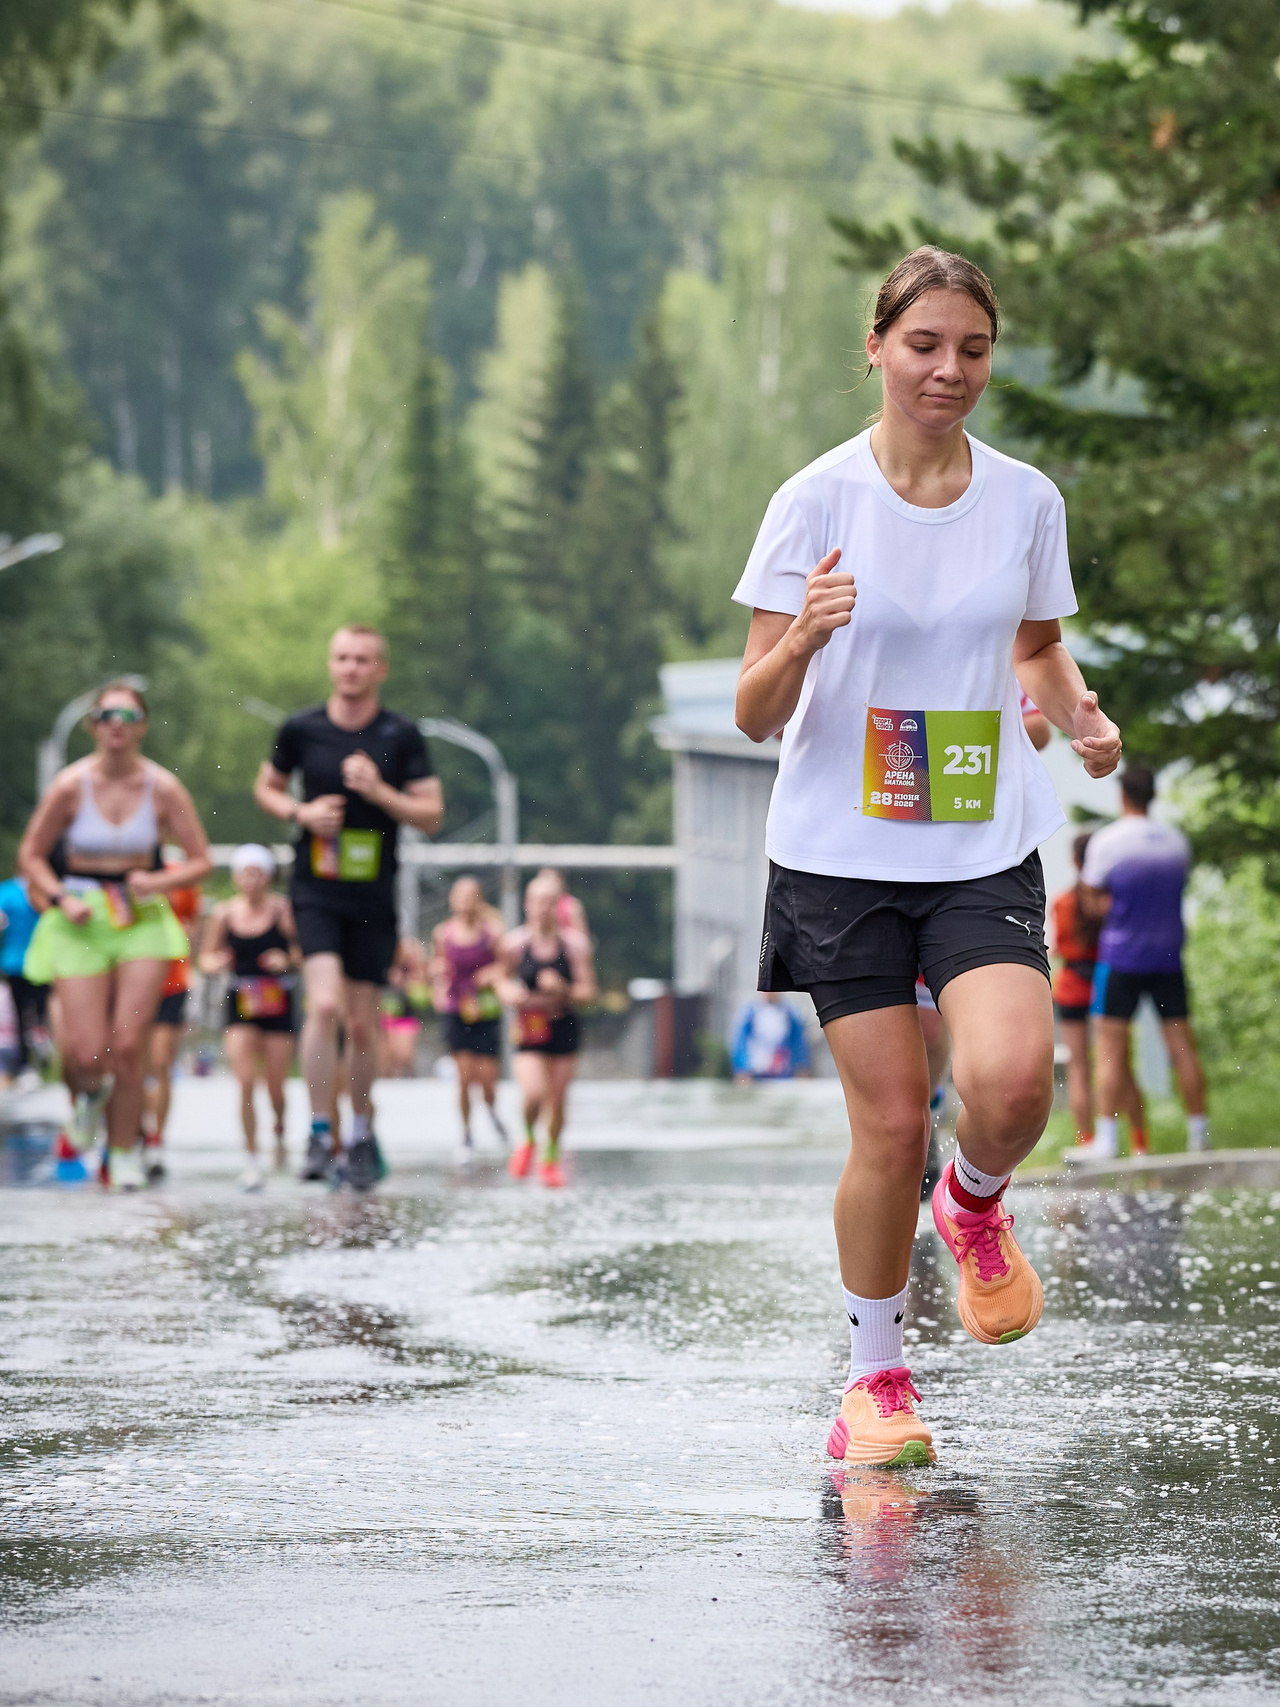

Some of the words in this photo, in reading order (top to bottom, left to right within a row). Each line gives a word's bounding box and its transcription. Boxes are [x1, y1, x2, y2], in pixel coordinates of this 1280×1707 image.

[943, 744, 992, 775] 231
[884, 770, 915, 780] АРЕНА
[884, 779, 915, 787] БИАТЛОНА
[870, 791, 893, 806] 28
[953, 797, 962, 809] 5
